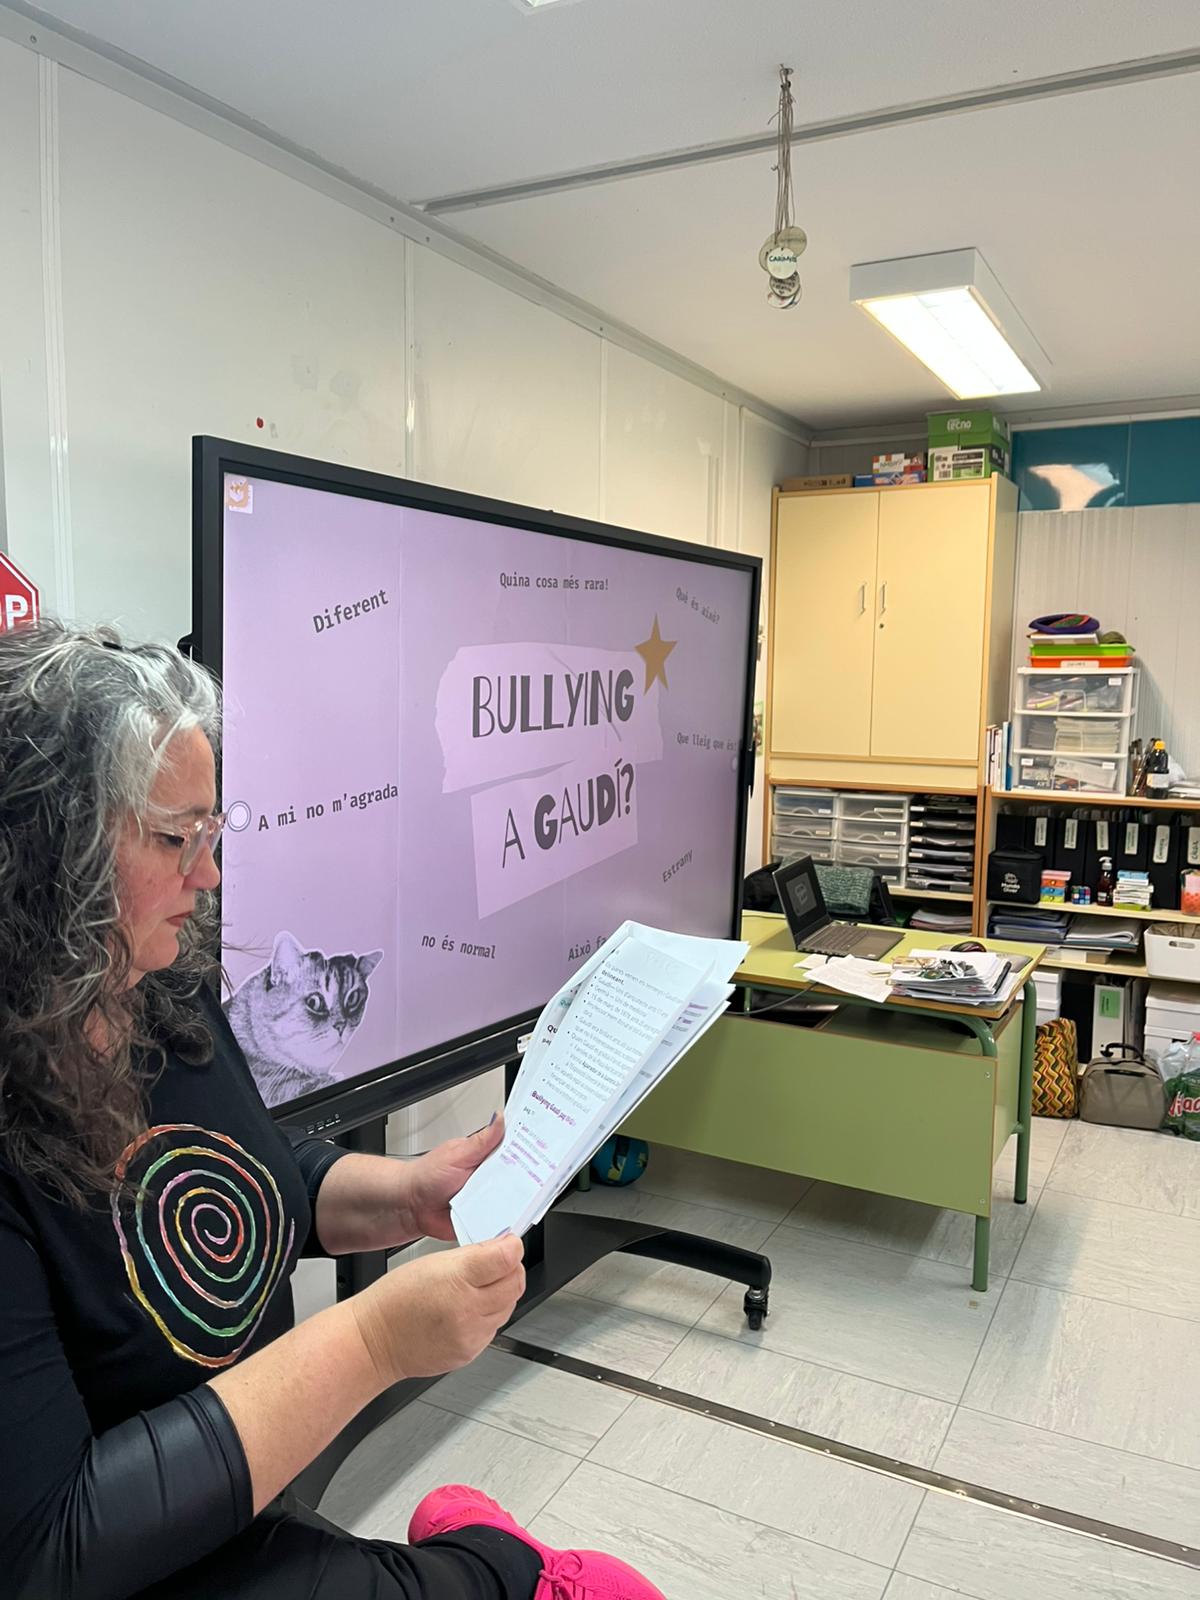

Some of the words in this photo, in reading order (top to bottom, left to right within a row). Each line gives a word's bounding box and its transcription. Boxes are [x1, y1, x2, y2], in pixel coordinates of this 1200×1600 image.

[500, 571, 530, 588] Quina
[536, 575, 558, 589] cosa
[563, 575, 579, 590] més
[584, 577, 609, 591] rara!
[0, 594, 28, 630] P
[313, 589, 389, 633] Diferent
[472, 669, 635, 738] BULLYING
[677, 732, 689, 745] Que
[692, 734, 711, 750] lleig
[713, 740, 724, 751] que
[258, 814, 269, 831] A
[277, 805, 297, 826] mi
[306, 803, 324, 819] no
[332, 783, 399, 812] m'agrada
[502, 808, 526, 869] A
[534, 757, 635, 850] GAUDÍ?
[661, 849, 694, 883] Estrany
[421, 934, 435, 948] no
[441, 935, 455, 951] és
[460, 941, 496, 959] normal
[568, 939, 591, 961] Això
